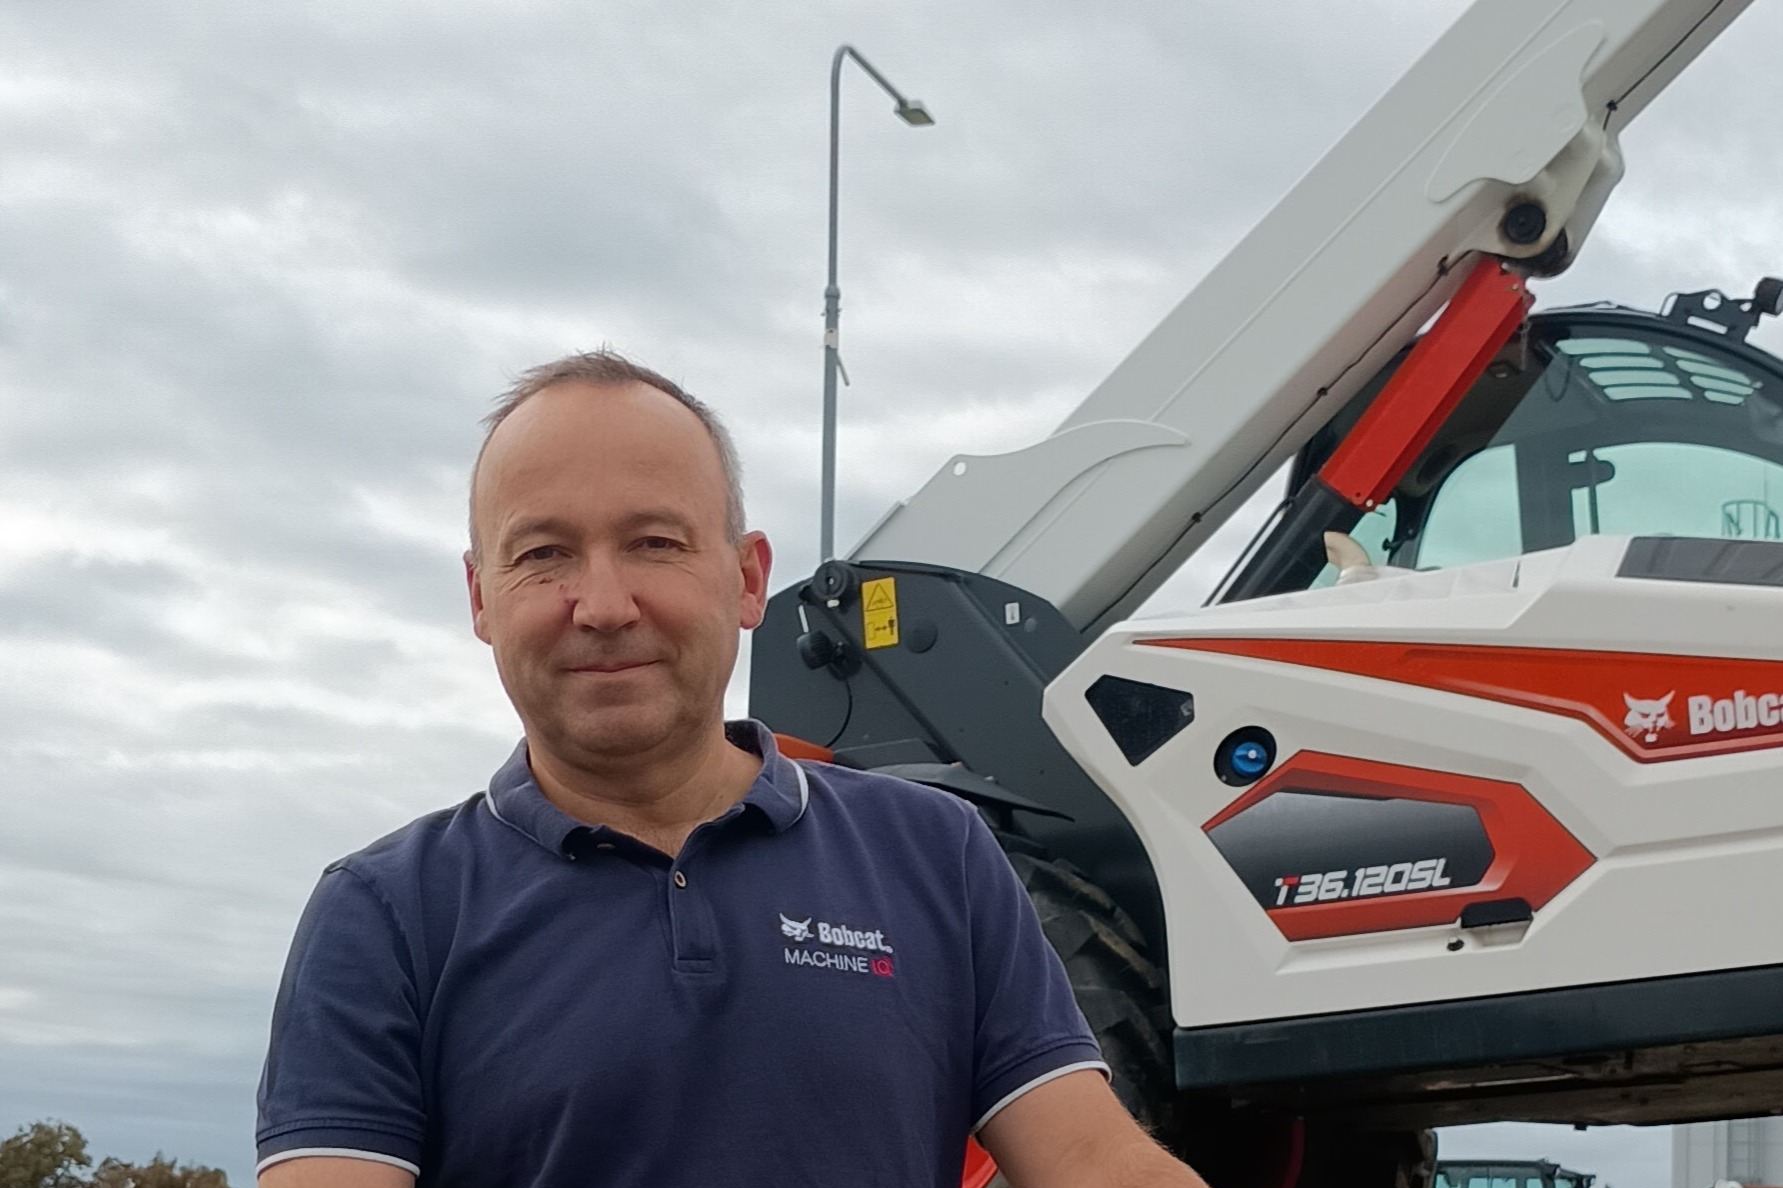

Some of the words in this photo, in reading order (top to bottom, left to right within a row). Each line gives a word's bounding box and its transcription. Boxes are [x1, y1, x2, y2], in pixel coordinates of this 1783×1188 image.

[1688, 689, 1783, 735] Bobc
[1274, 857, 1452, 906] T36.120SL
[817, 921, 889, 951] Bobcat
[784, 947, 870, 973] MACHINE
[871, 956, 893, 978] IQ
